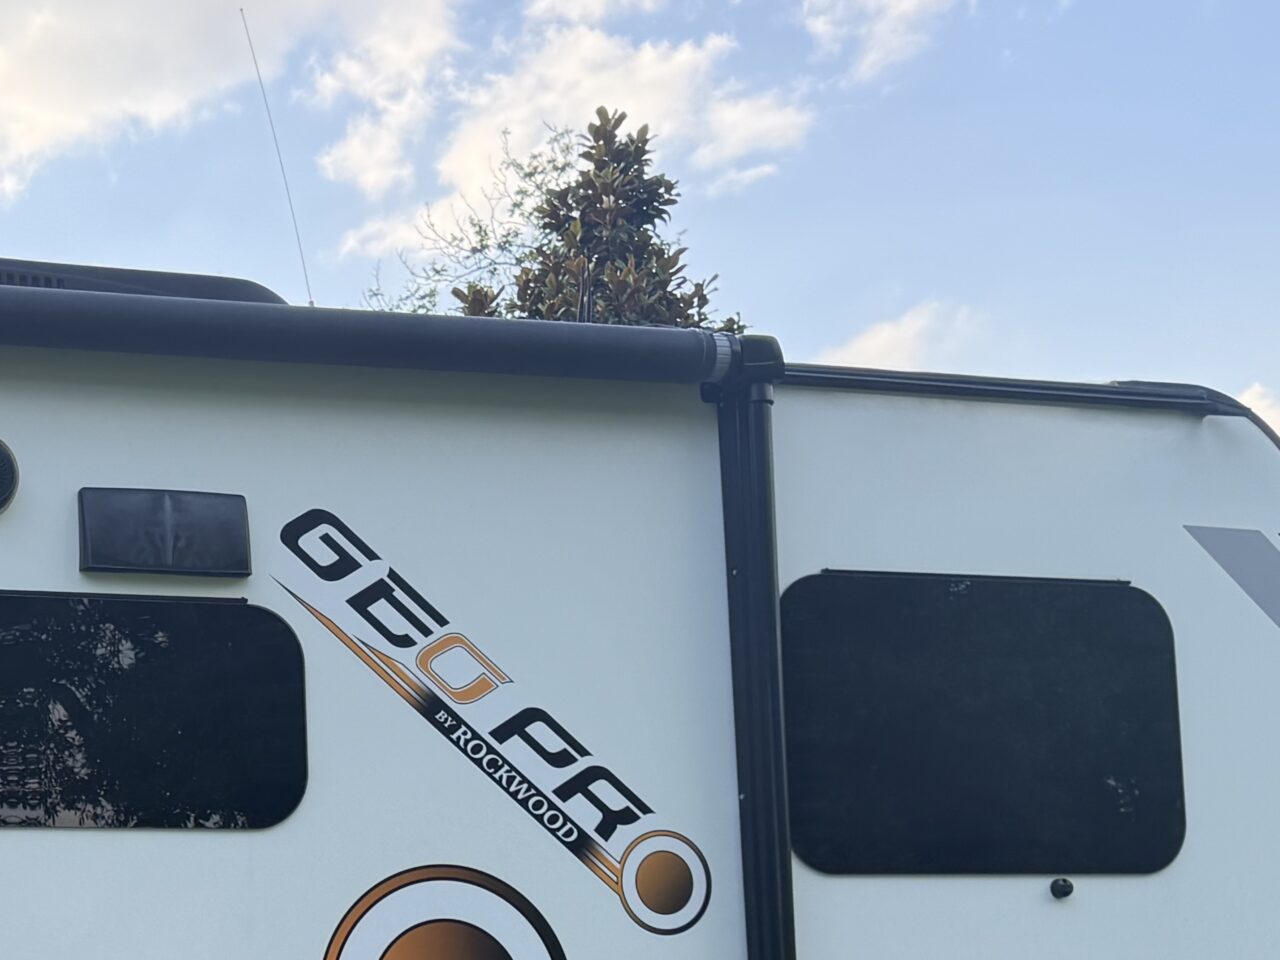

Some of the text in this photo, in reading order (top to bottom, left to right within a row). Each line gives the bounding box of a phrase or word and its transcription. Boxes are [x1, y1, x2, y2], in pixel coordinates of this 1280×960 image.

[279, 508, 514, 705] GEO
[433, 709, 579, 845] BY ROCKWOOD
